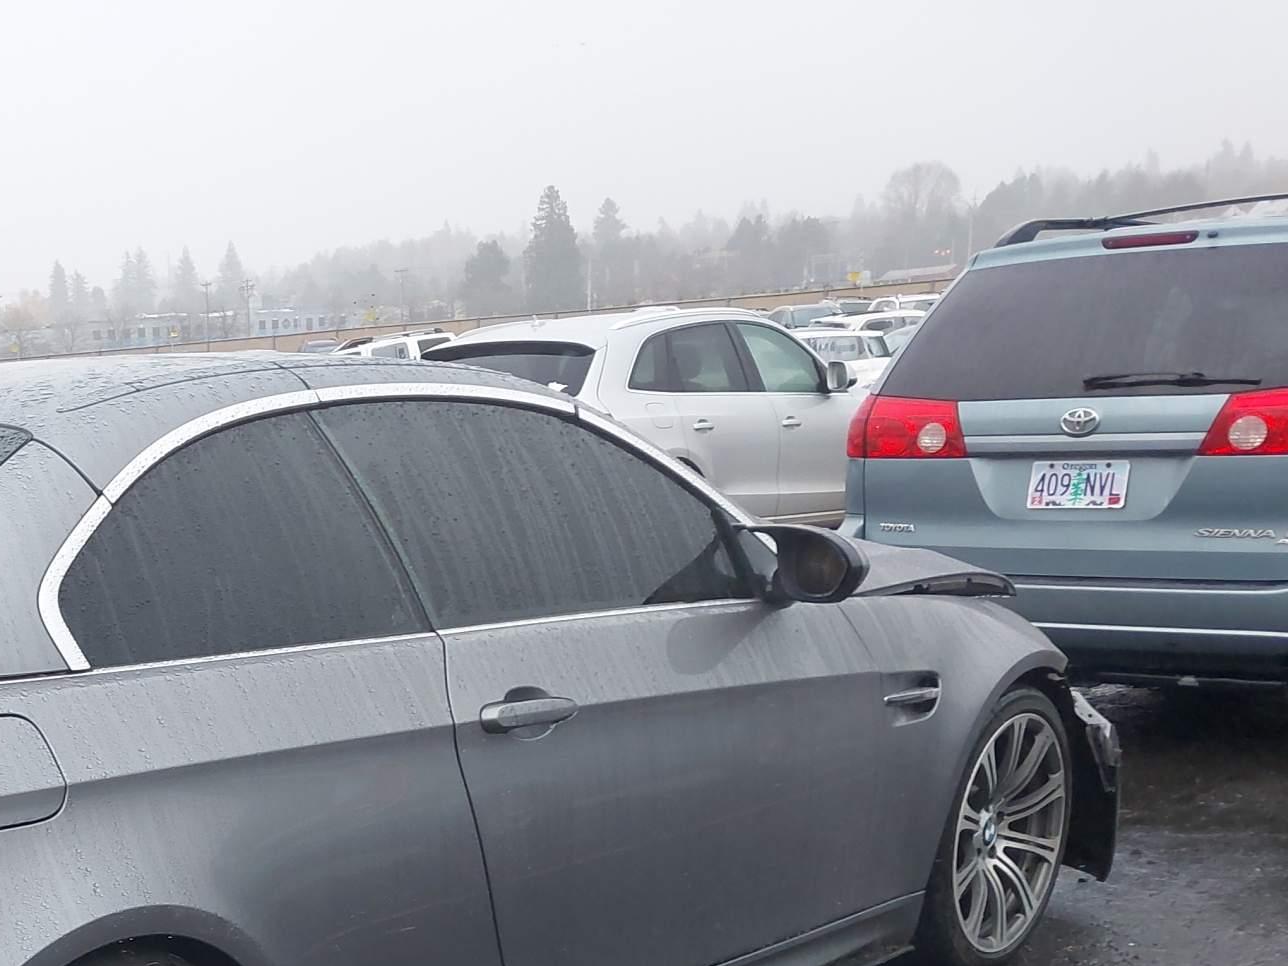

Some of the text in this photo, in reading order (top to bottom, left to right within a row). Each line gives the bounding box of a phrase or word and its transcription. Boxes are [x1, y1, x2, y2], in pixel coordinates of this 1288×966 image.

[1062, 462, 1097, 472] Oregon
[1034, 472, 1120, 497] 409 NVL
[879, 522, 915, 533] TOYOTA
[1193, 528, 1276, 538] SIENNA
